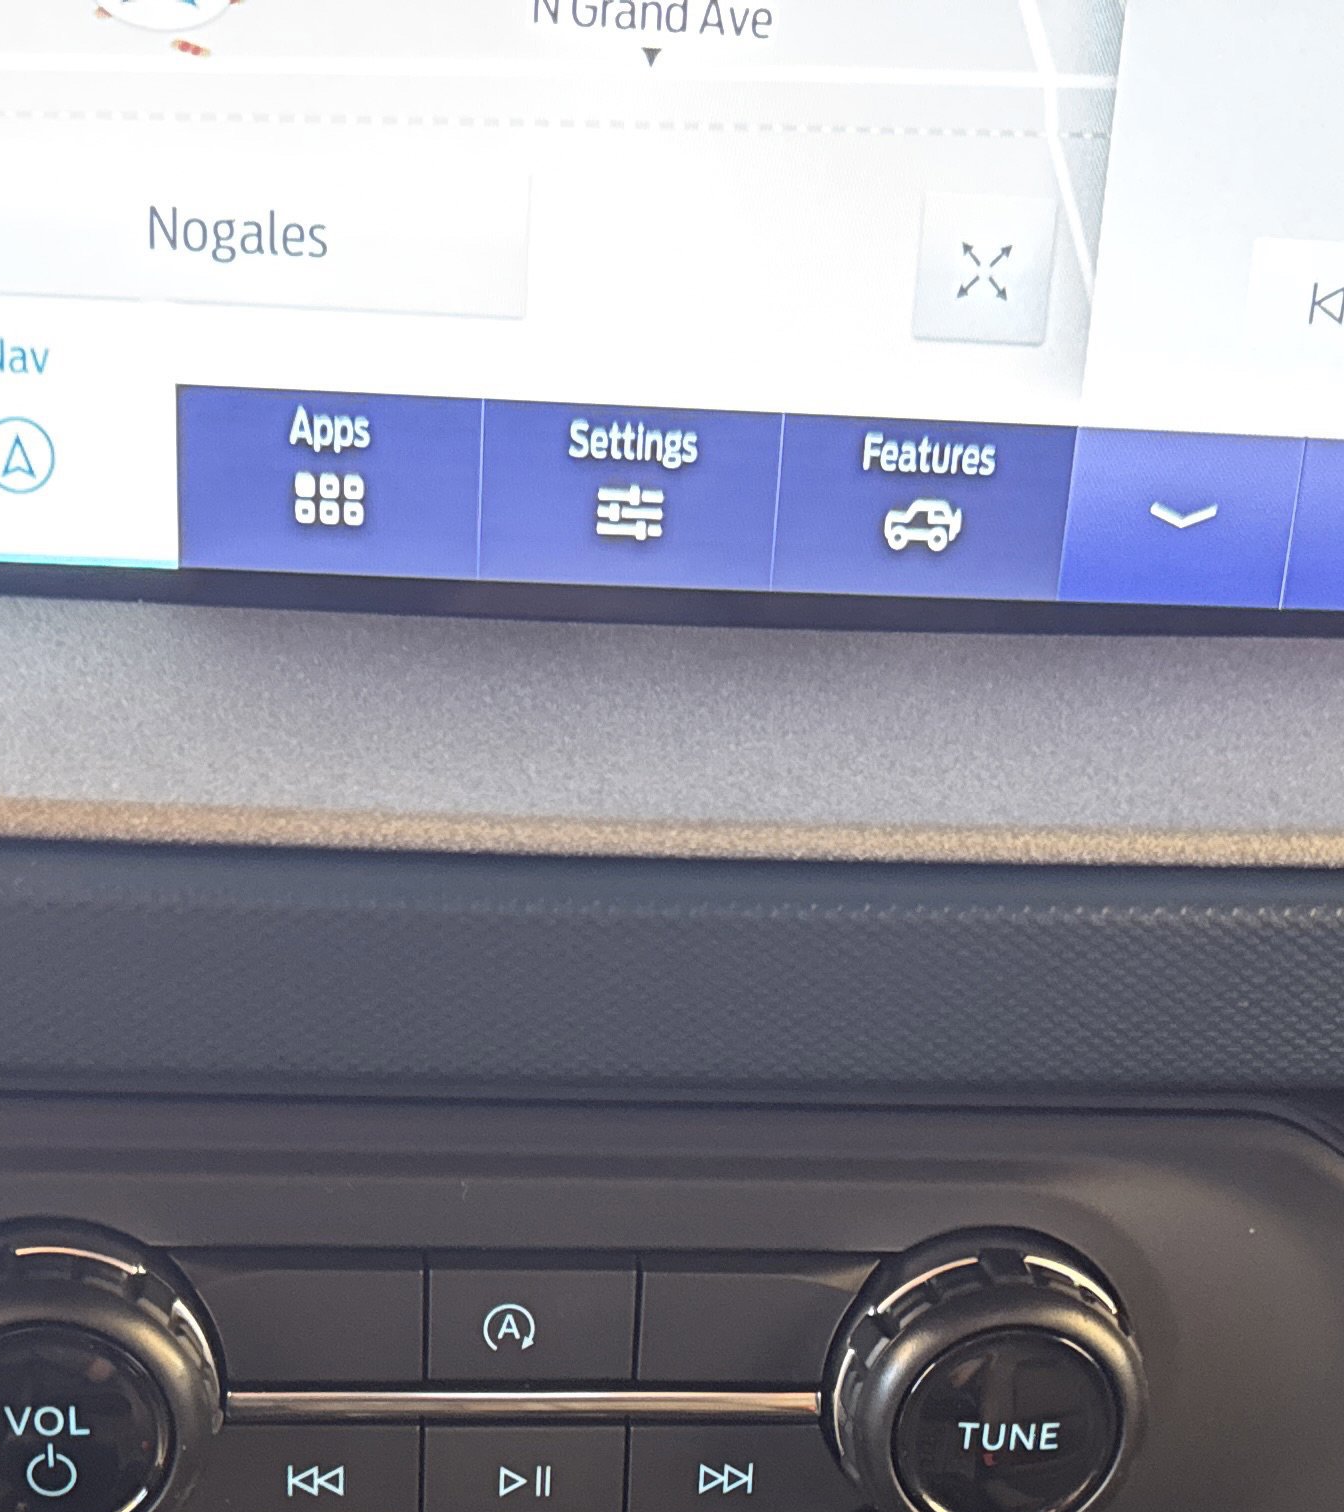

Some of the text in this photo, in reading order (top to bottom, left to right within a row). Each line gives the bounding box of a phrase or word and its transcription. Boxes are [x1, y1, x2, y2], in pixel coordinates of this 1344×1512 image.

[571, 0, 690, 34] Grand
[699, 0, 773, 40] Ave
[148, 204, 329, 264] Nogales
[288, 404, 372, 454] Apps
[568, 417, 699, 469] Settings
[861, 431, 997, 477] Features
[3, 1404, 91, 1438] VOL
[957, 1421, 1061, 1451] TUNE
